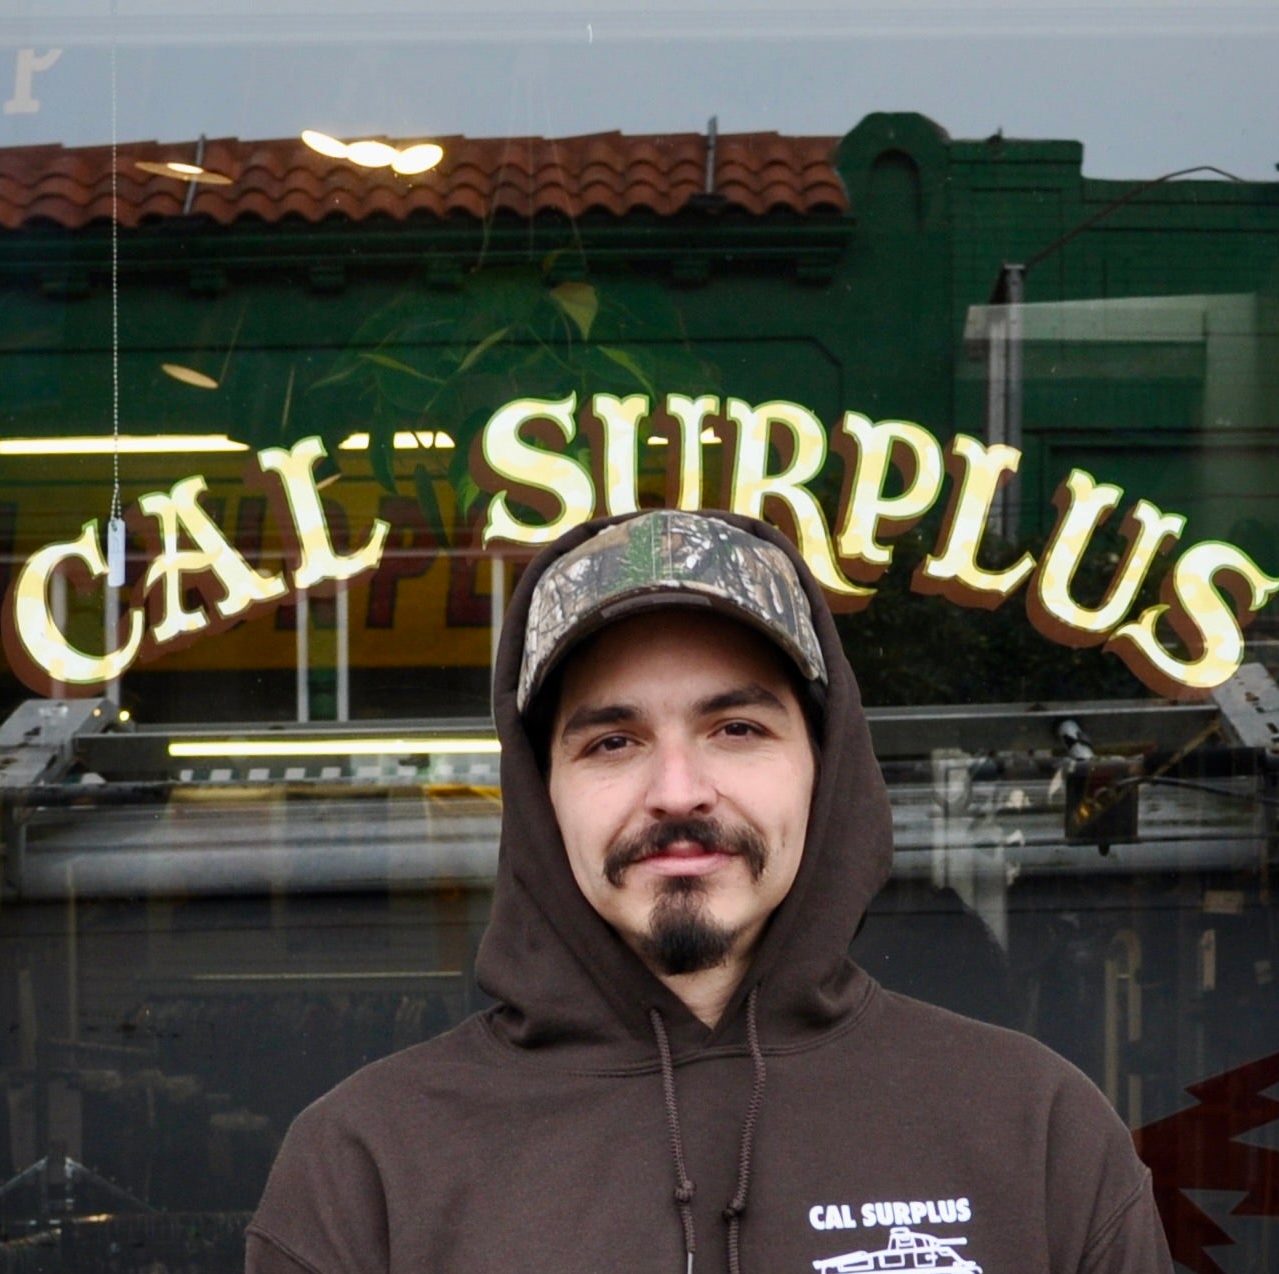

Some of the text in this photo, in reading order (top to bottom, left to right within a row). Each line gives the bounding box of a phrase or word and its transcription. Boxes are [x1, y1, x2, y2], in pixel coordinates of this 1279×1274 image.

[11, 434, 392, 688] CAL
[808, 1197, 972, 1230] CAL SURPLUS
